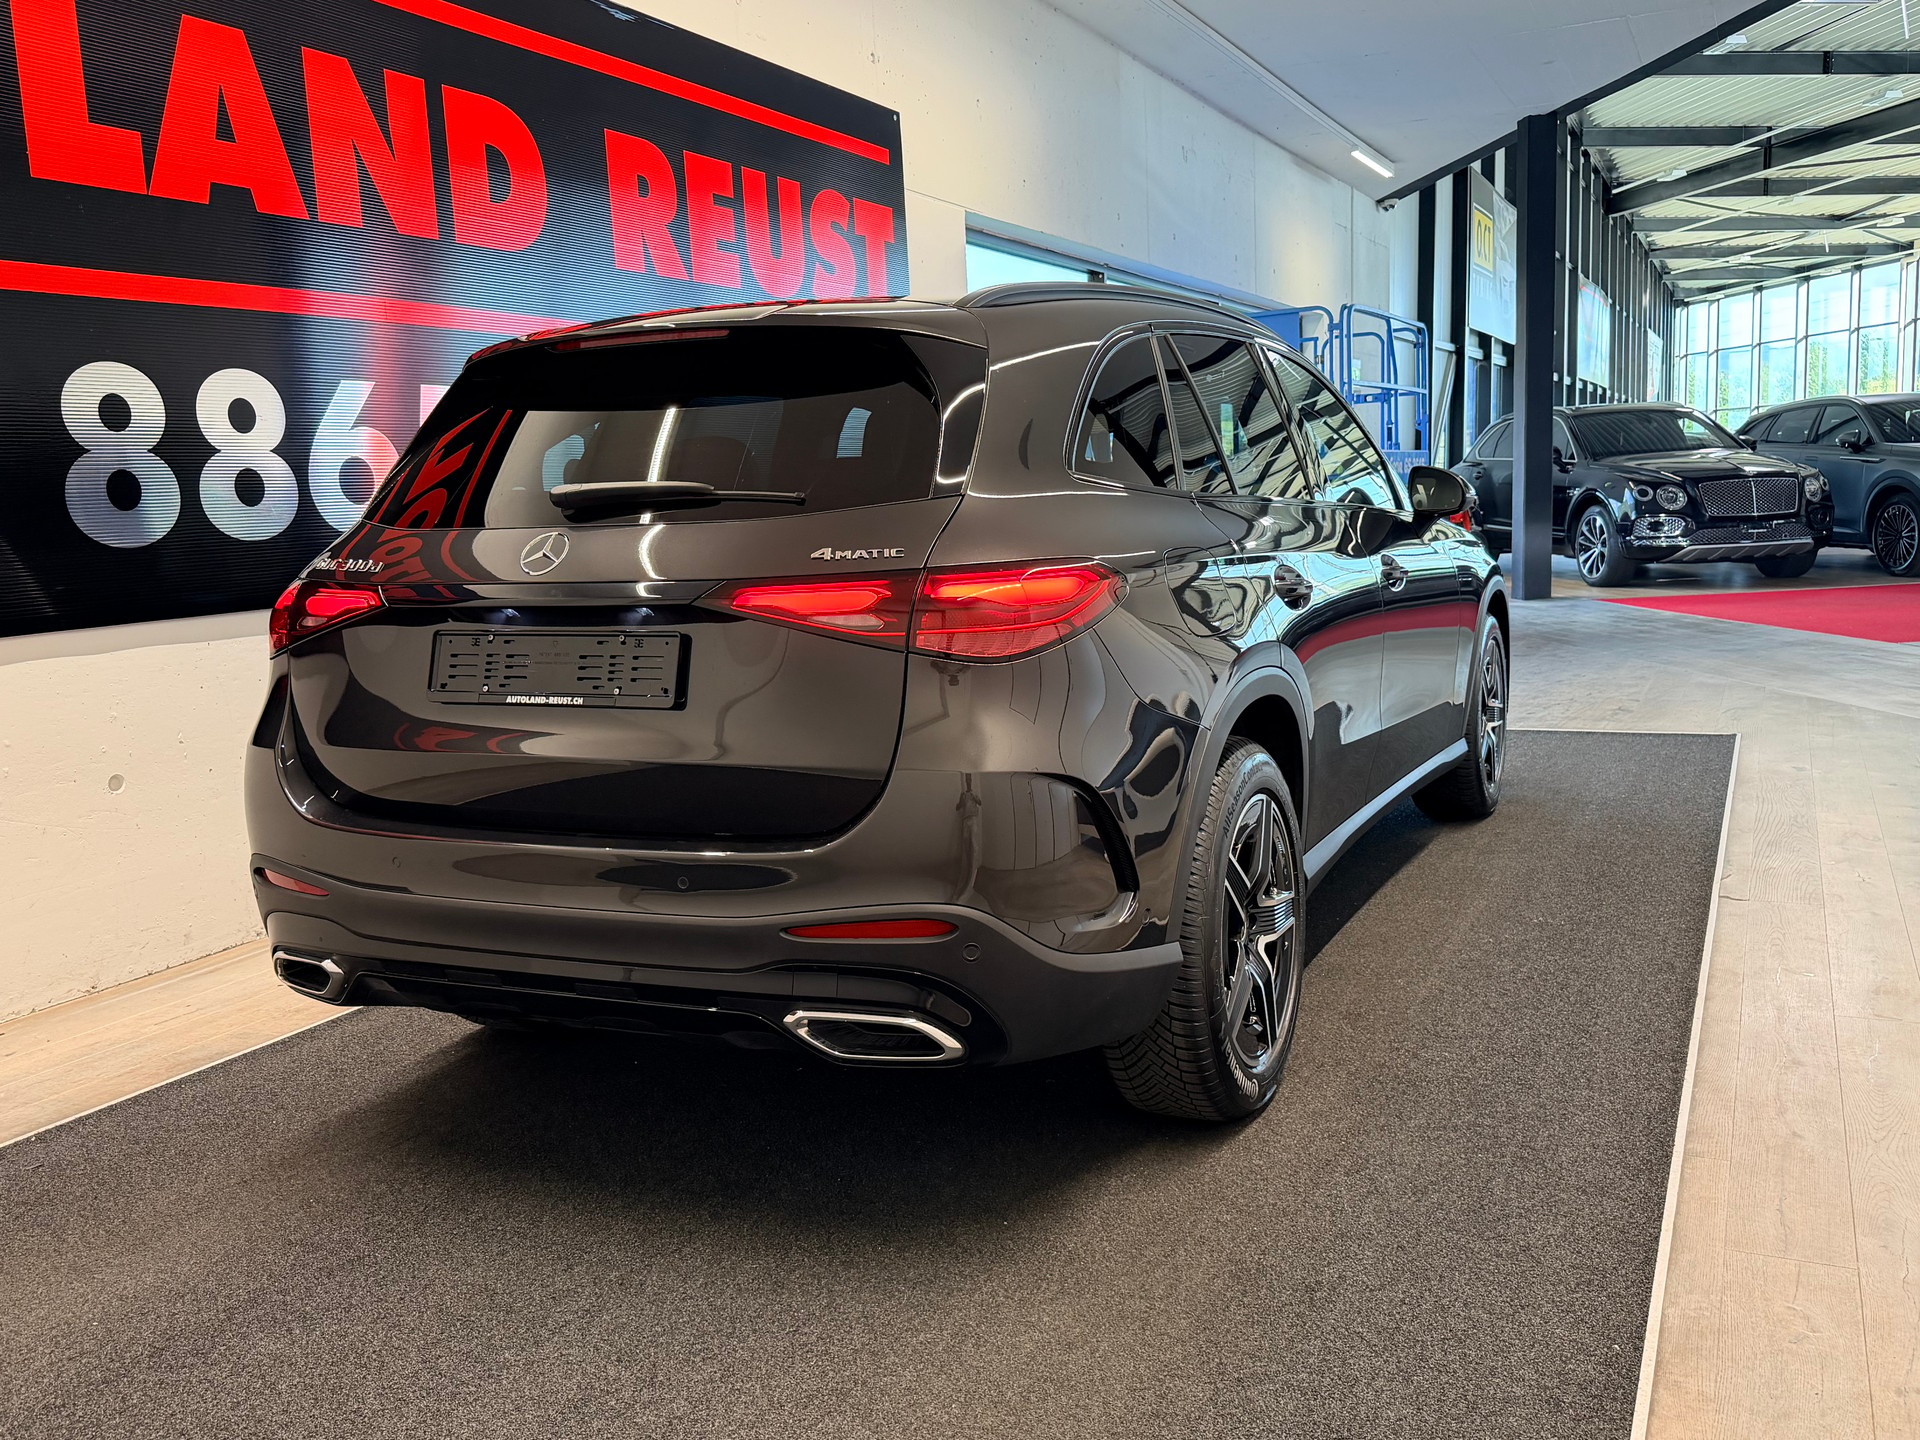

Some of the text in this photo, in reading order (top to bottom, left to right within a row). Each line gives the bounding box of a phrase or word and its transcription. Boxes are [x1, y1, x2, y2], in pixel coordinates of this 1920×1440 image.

[604, 128, 895, 299] REUST
[60, 360, 450, 549] 886
[810, 547, 905, 561] 4MATIC
[505, 695, 584, 705] AUTOLAND-REUST.CH
[1221, 1034, 1259, 1103] Continental
